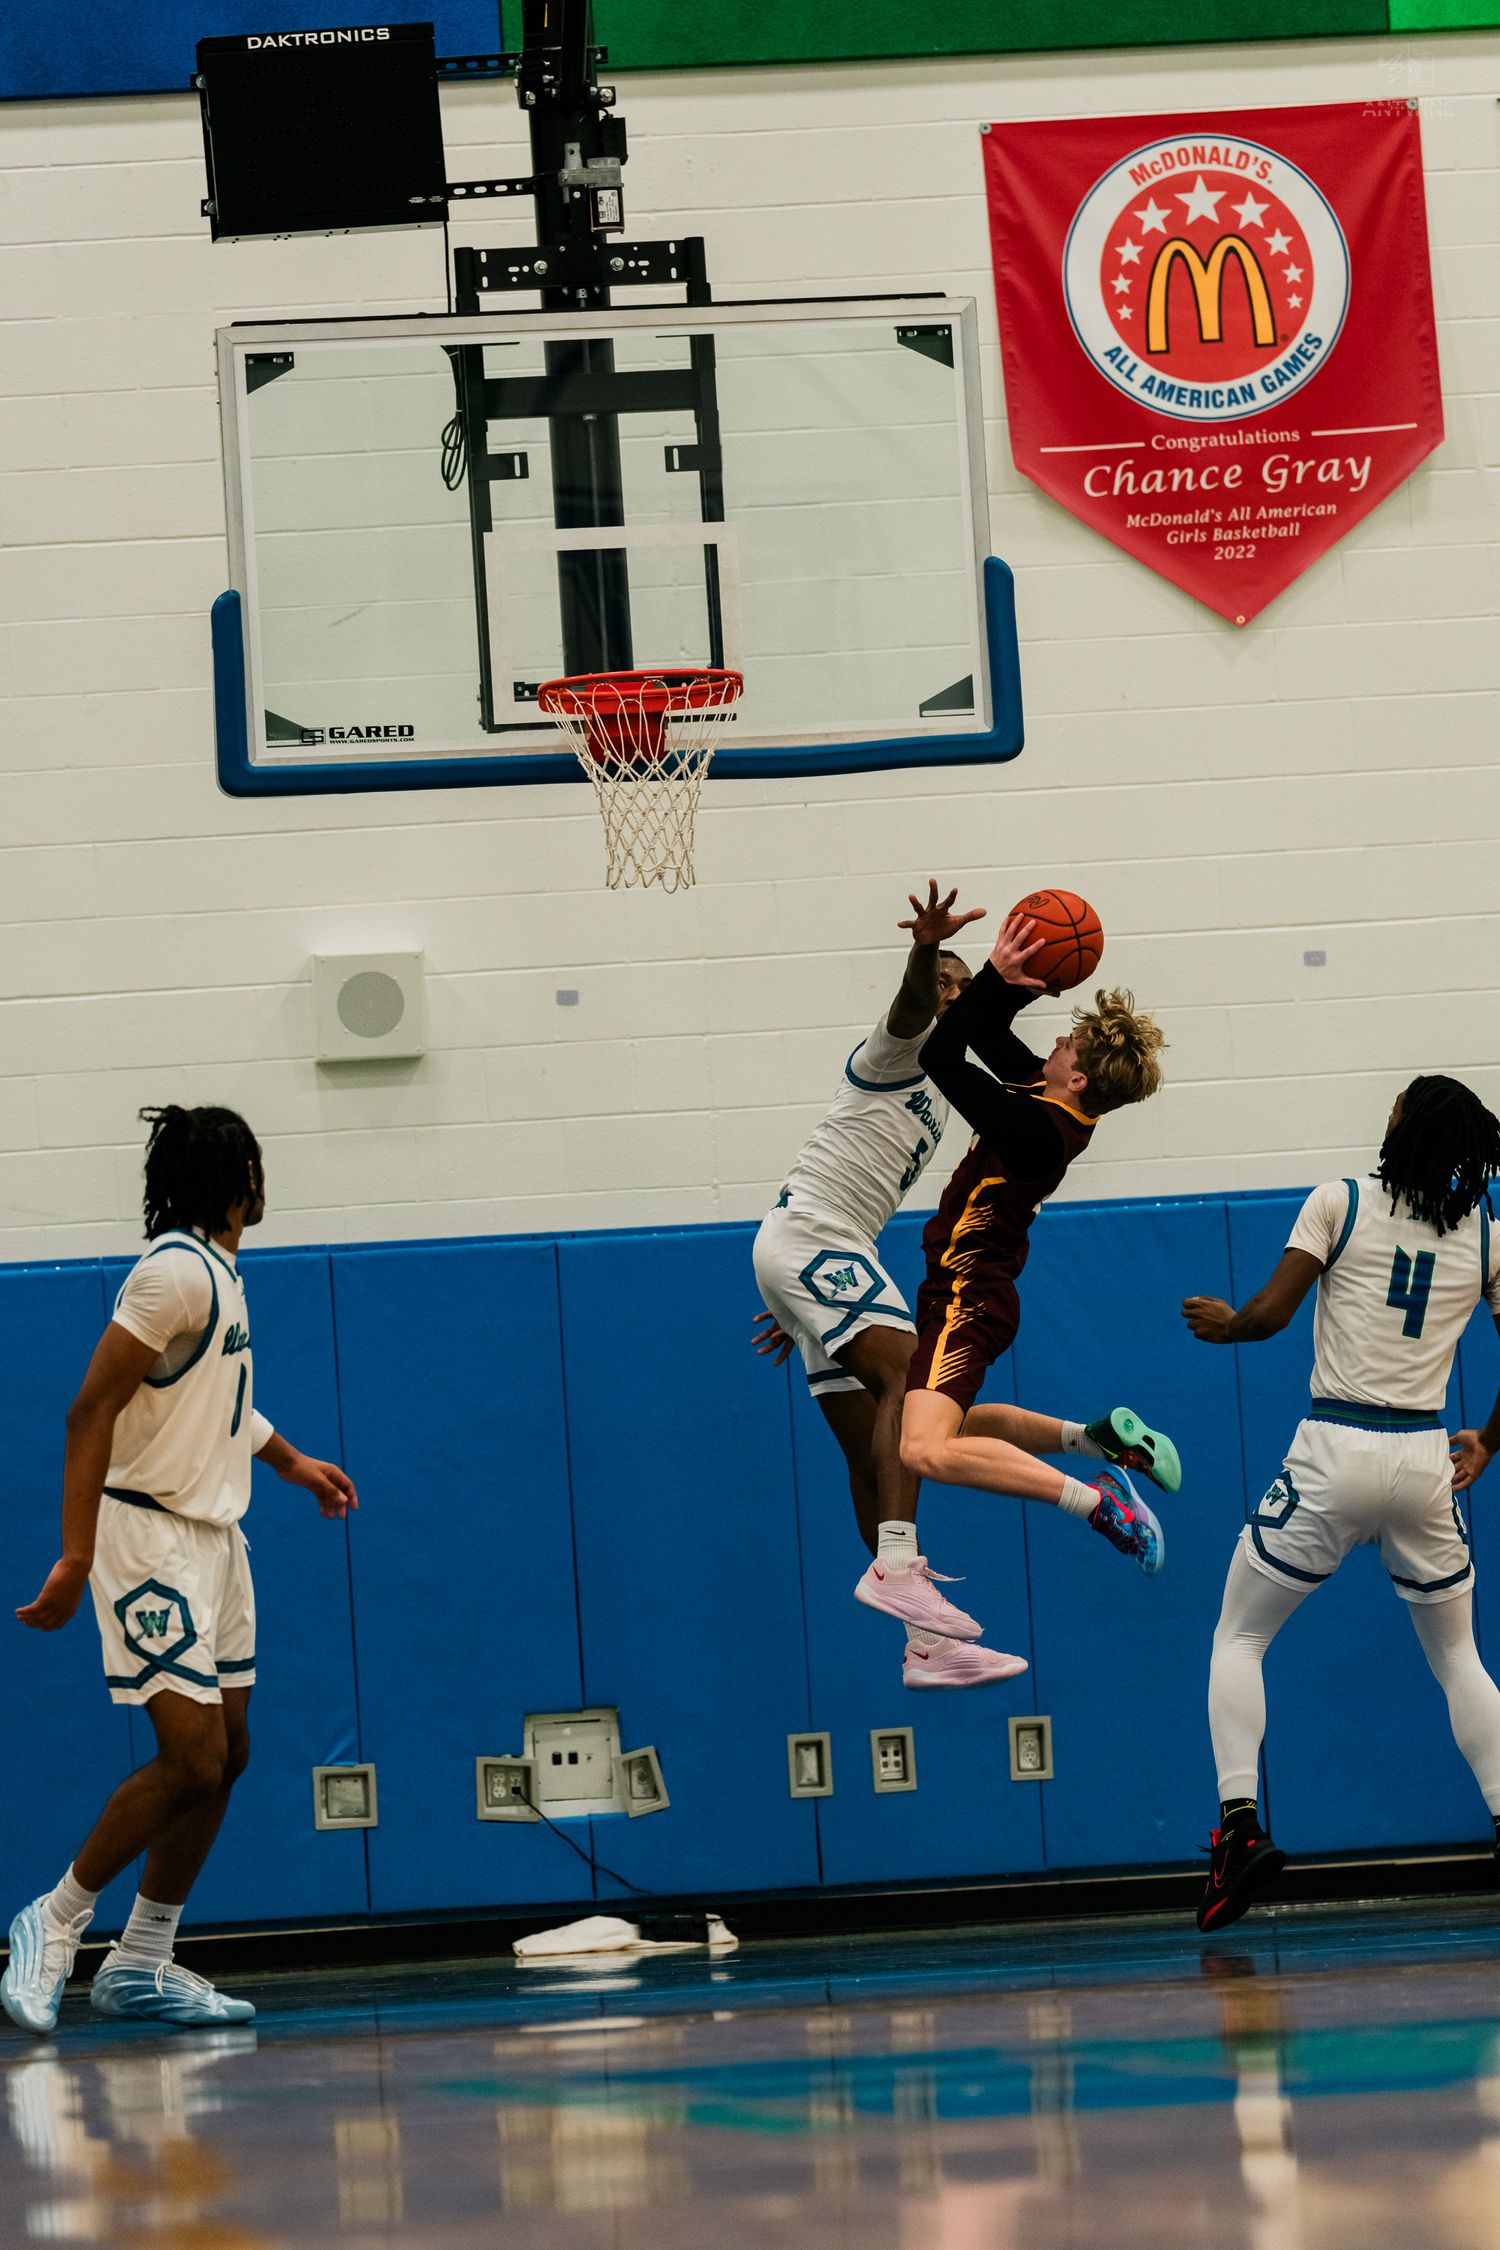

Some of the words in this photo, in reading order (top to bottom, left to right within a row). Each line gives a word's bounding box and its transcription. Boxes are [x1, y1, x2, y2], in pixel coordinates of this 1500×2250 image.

[246, 28, 391, 50] DAKTRONICS
[1128, 145, 1272, 186] McDONALD'S
[1103, 345, 1136, 382] ALL
[1140, 374, 1257, 409] AMERICAN
[1260, 332, 1324, 395] GAMES
[1151, 429, 1300, 452] Congratulations
[1083, 458, 1244, 497] Chance
[1261, 453, 1372, 493] Gray
[1126, 509, 1223, 528] McDonald's
[1227, 506, 1251, 521] All
[1256, 503, 1338, 520] American
[1166, 528, 1208, 545] Girls
[1213, 522, 1301, 541] Basketball
[1214, 544, 1257, 561] 2022
[328, 725, 415, 739] GARED
[1385, 1244, 1435, 1340] 4
[230, 1362, 247, 1438] 1
[135, 1608, 171, 1639] W
